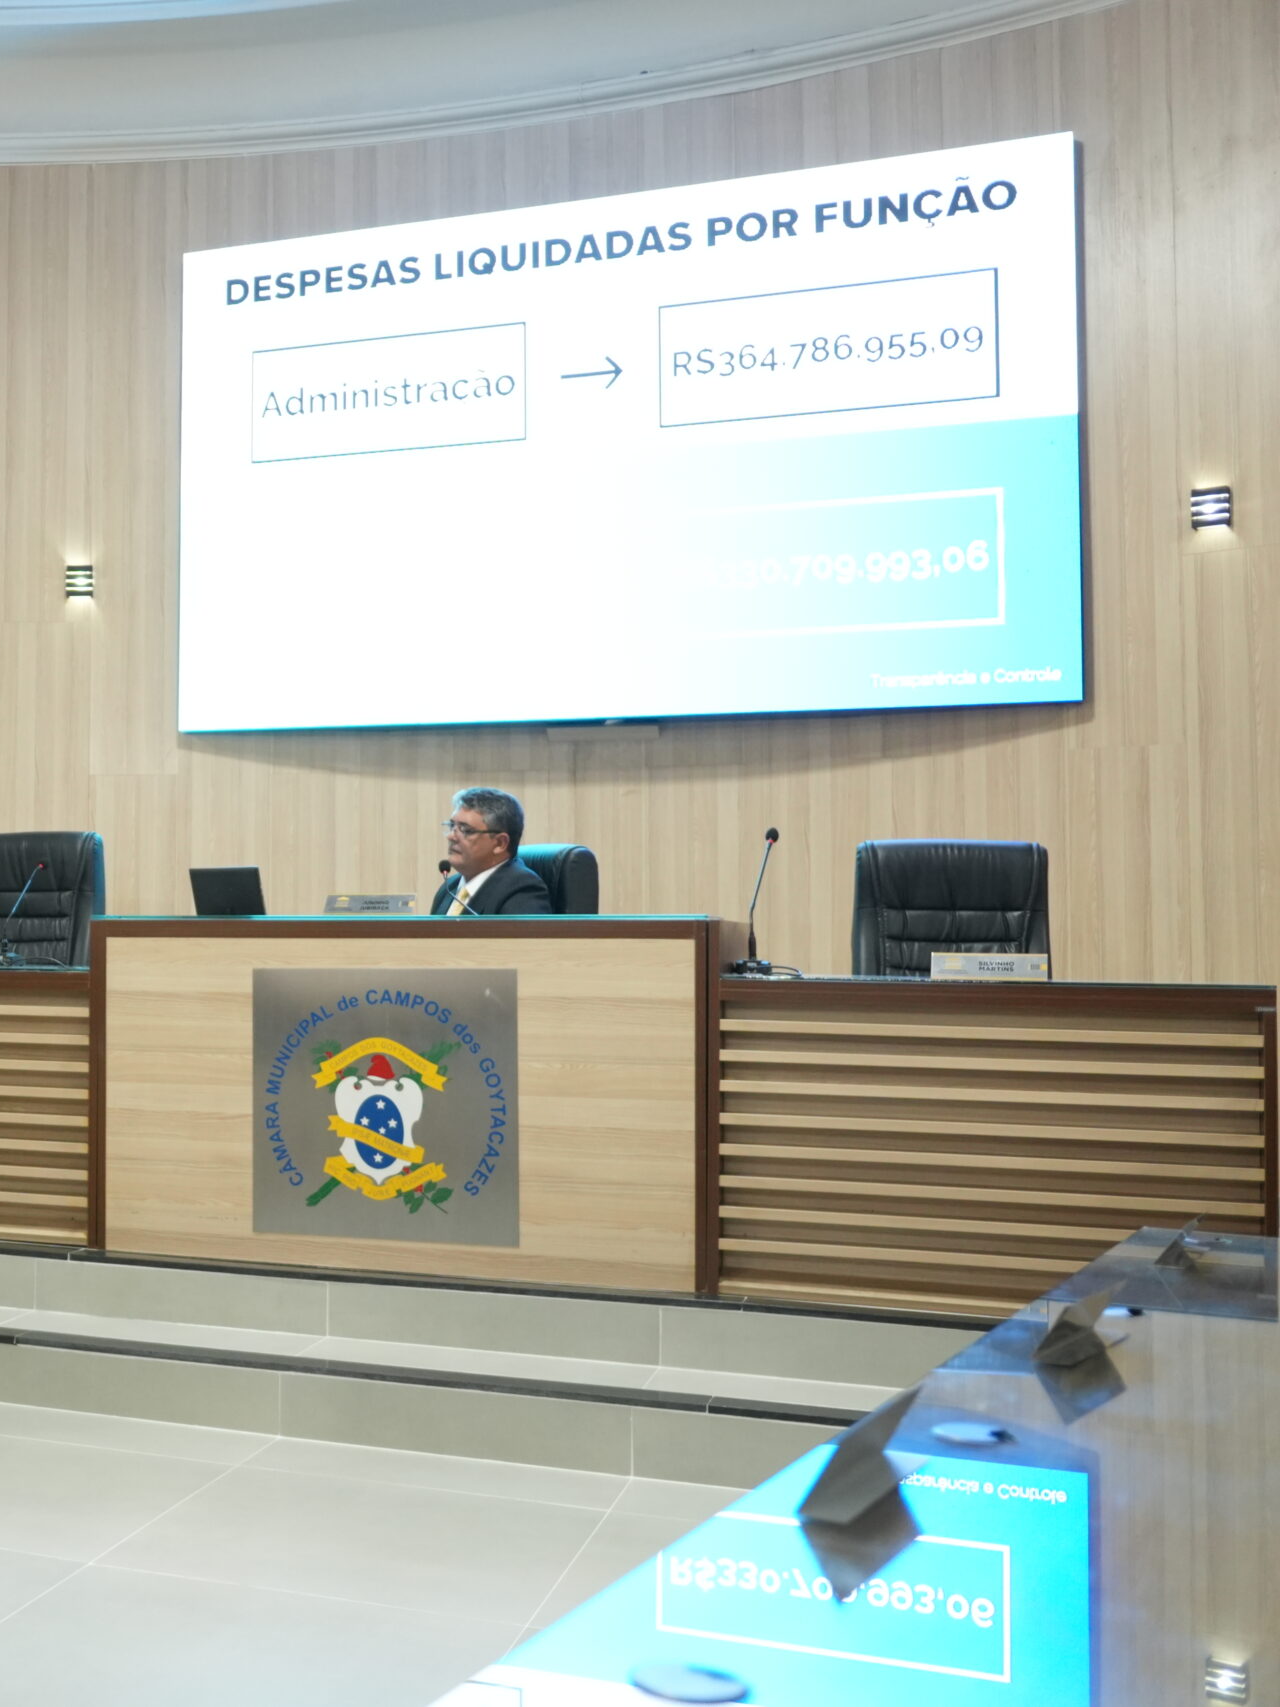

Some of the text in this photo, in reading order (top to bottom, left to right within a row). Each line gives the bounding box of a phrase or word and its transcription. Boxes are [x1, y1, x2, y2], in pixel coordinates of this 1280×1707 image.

[226, 175, 1018, 306] DESPESAS LIQUIDADAS POR FUNÇÃO
[980, 671, 991, 685] e
[993, 666, 1062, 683] Controle
[337, 995, 360, 1012] de
[365, 989, 453, 1025] CAMPOS
[266, 1006, 334, 1095] MUNICIPAL
[452, 1022, 481, 1055] dos
[463, 1057, 508, 1197] GOYTACAZES
